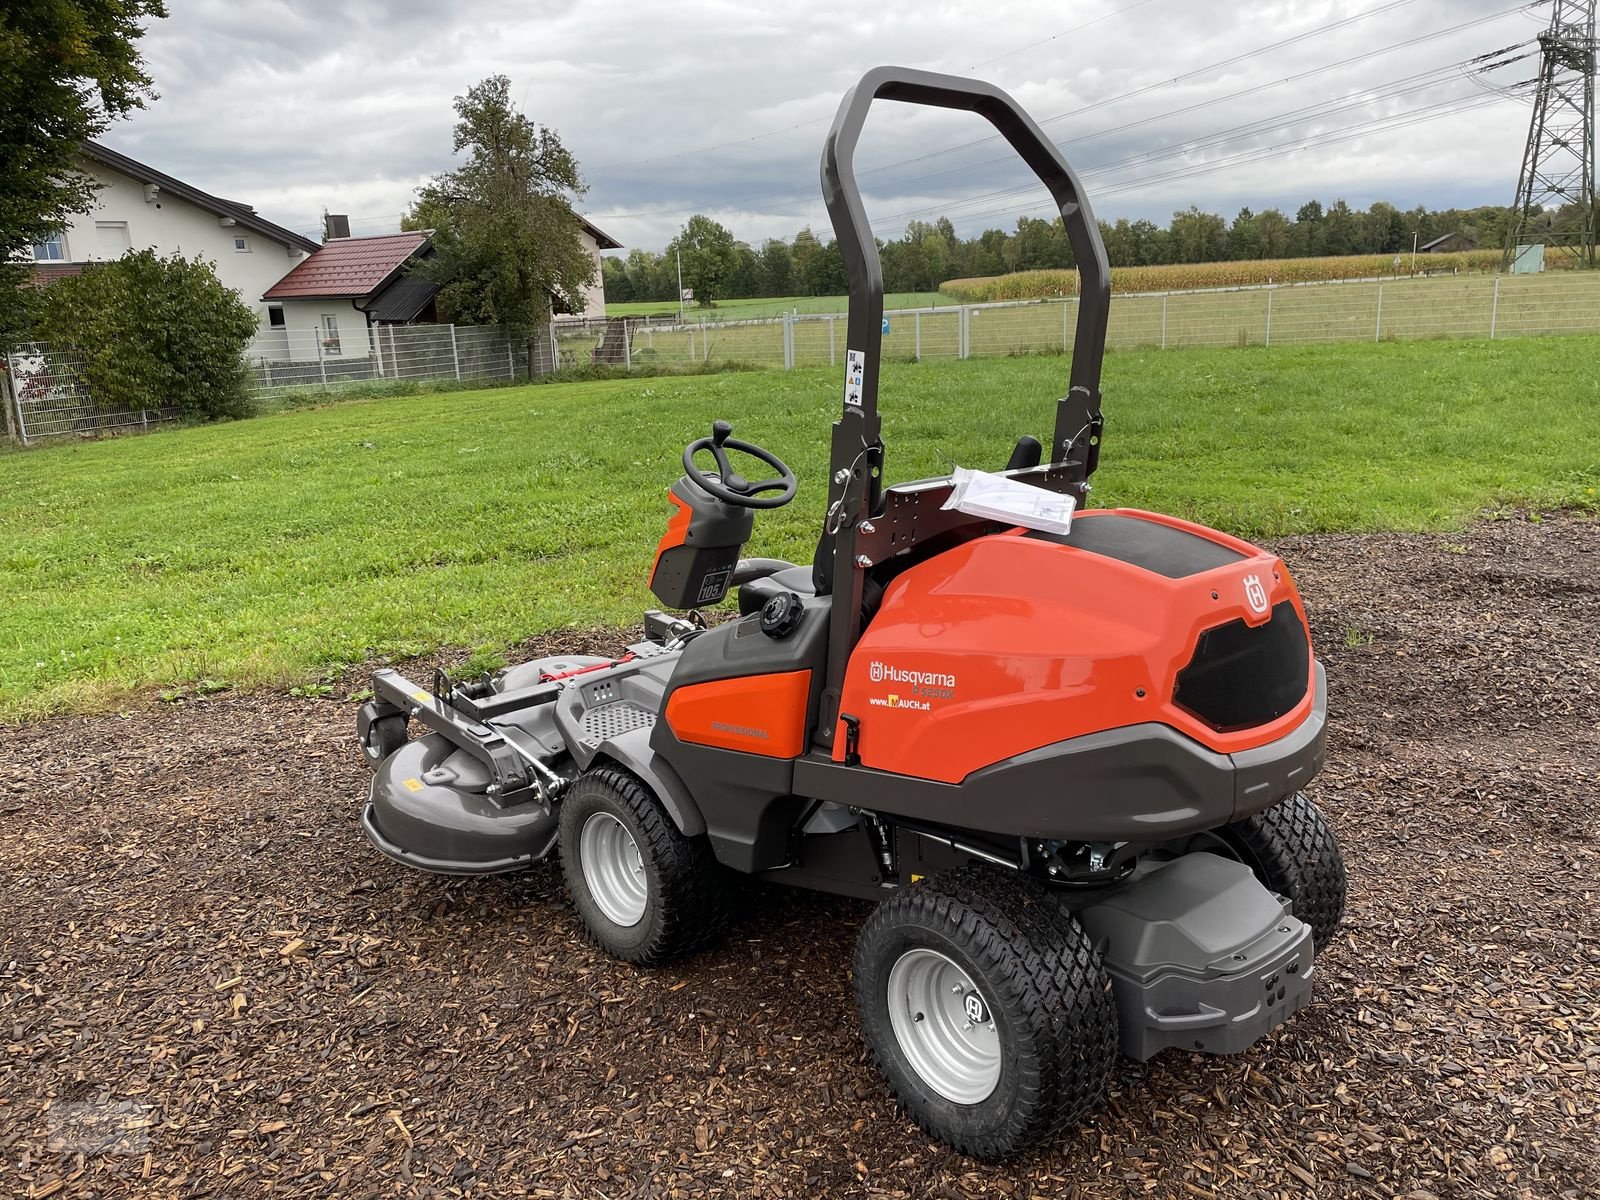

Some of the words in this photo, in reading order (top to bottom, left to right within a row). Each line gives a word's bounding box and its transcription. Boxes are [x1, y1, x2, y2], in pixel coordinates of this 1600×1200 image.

[882, 318, 889, 332] P
[702, 584, 720, 599] 105
[884, 665, 955, 687] Husqvarna
[912, 685, 919, 695] P
[870, 695, 930, 710] www.MAUCH.at
